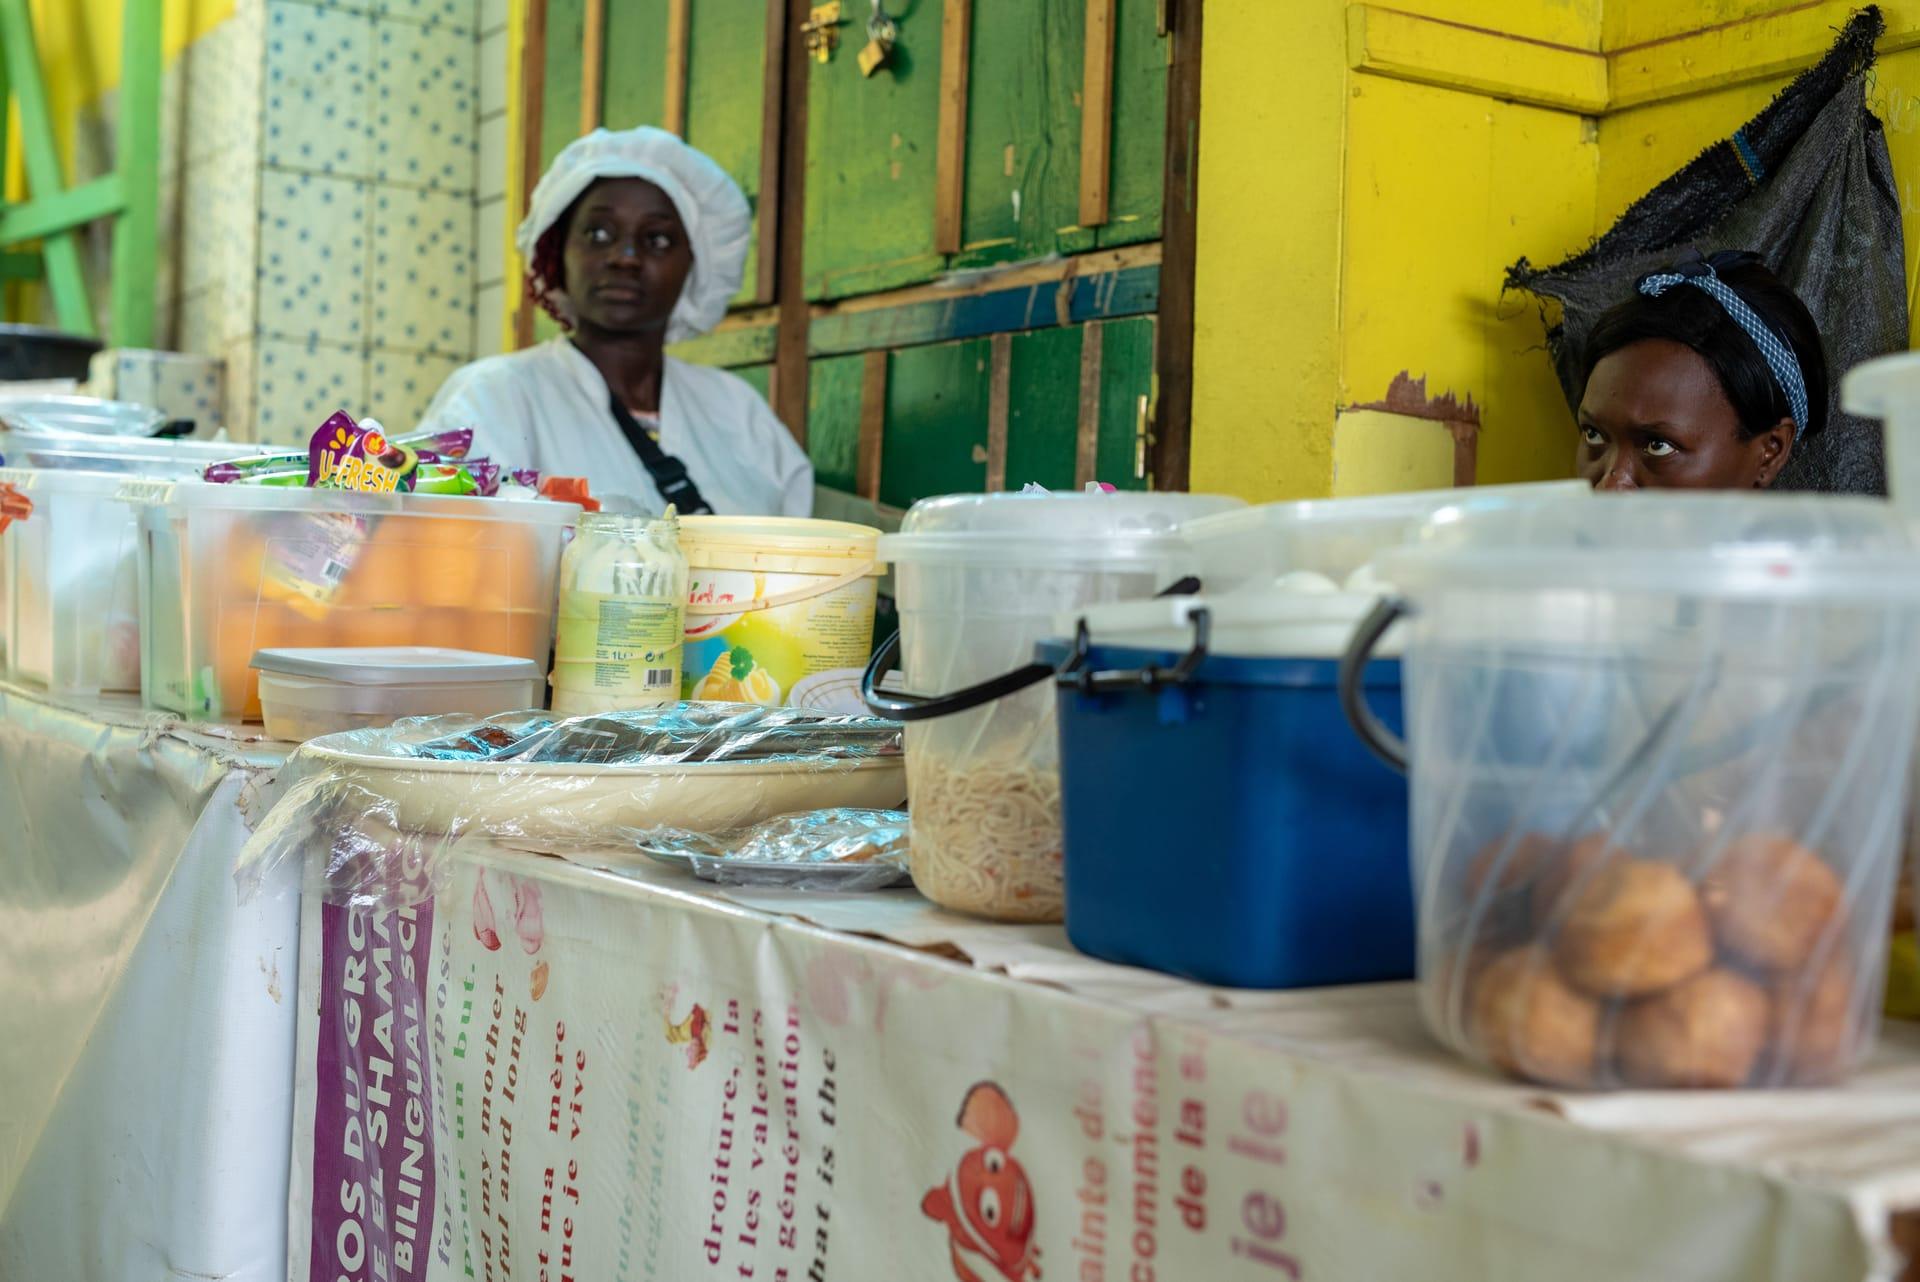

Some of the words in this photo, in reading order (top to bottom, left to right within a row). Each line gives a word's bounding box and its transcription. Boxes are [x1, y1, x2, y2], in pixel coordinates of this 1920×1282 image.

[319, 449, 400, 492] U-FRESH
[435, 920, 452, 1137] purpose.
[453, 963, 476, 1060] but.
[481, 973, 505, 1137] mother
[502, 1004, 528, 1104] long
[343, 1066, 364, 1163] DU
[455, 1080, 465, 1141] un
[538, 1166, 555, 1234] ma
[548, 1019, 566, 1135] mère
[570, 1048, 588, 1141] vive
[738, 1189, 762, 1249] les
[750, 1007, 769, 1170] valeurs
[818, 1048, 838, 1126] the
[1174, 1098, 1208, 1149] la
[1227, 1090, 1288, 1166] le
[394, 997, 425, 1275] BILINGUAL
[498, 1119, 513, 1204] and
[703, 1065, 743, 1266] droiture,
[723, 998, 740, 1035] la
[816, 1145, 835, 1186] is
[372, 1167, 388, 1235] EL
[454, 1158, 475, 1278] pour
[481, 1147, 493, 1217] my
[562, 1157, 580, 1205] je
[1174, 1164, 1208, 1233] de
[336, 1179, 366, 1282] OS
[437, 1201, 453, 1270] for
[497, 1217, 512, 1282] ful
[1230, 1190, 1301, 1282] je
